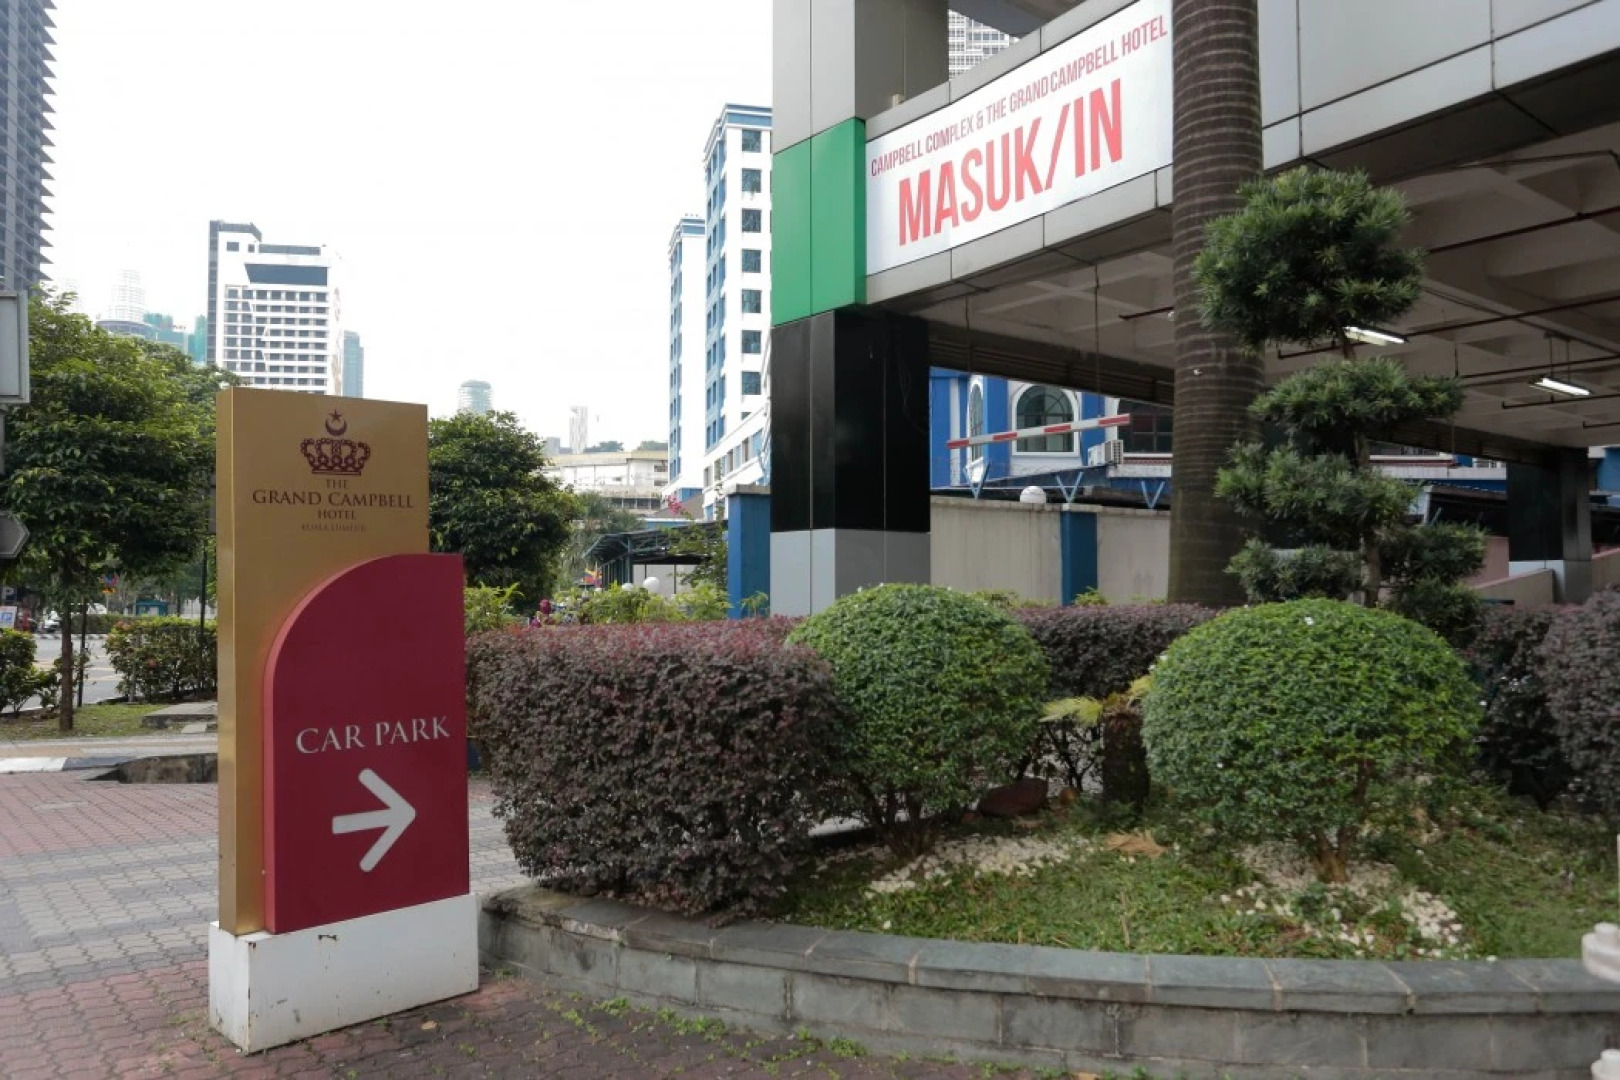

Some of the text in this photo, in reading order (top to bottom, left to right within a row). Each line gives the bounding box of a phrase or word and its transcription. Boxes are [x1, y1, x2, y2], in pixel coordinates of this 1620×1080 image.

[871, 14, 1167, 176] CAMPBELL COMPLEX & THE GRAND CAMPBELL HOTEL
[325, 479, 349, 489] THE
[252, 489, 414, 508] GRAND CAMPBELL
[317, 509, 356, 520] HOTEL
[296, 715, 450, 754] CAR PARK
